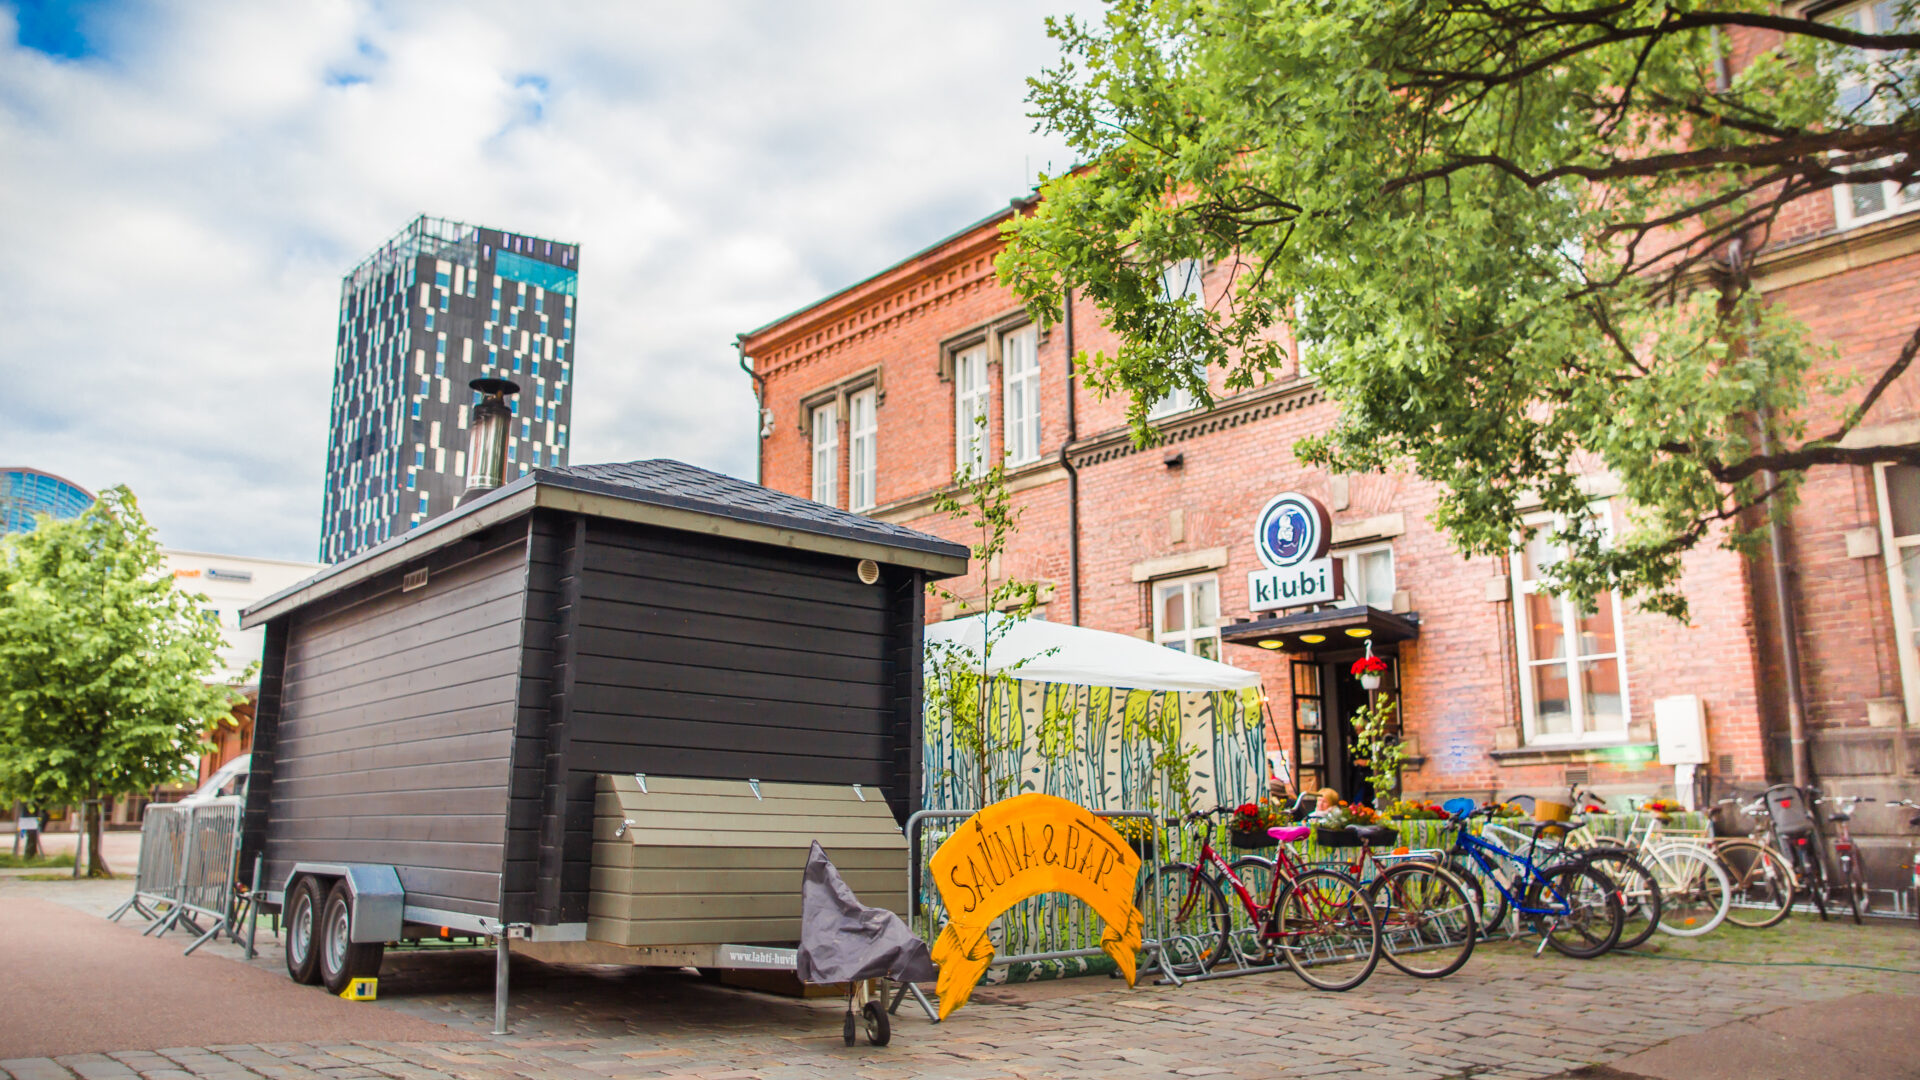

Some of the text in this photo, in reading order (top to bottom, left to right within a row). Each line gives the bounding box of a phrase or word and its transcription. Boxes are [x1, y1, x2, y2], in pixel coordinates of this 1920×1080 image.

[951, 822, 1113, 912] SAUNA & BAR
